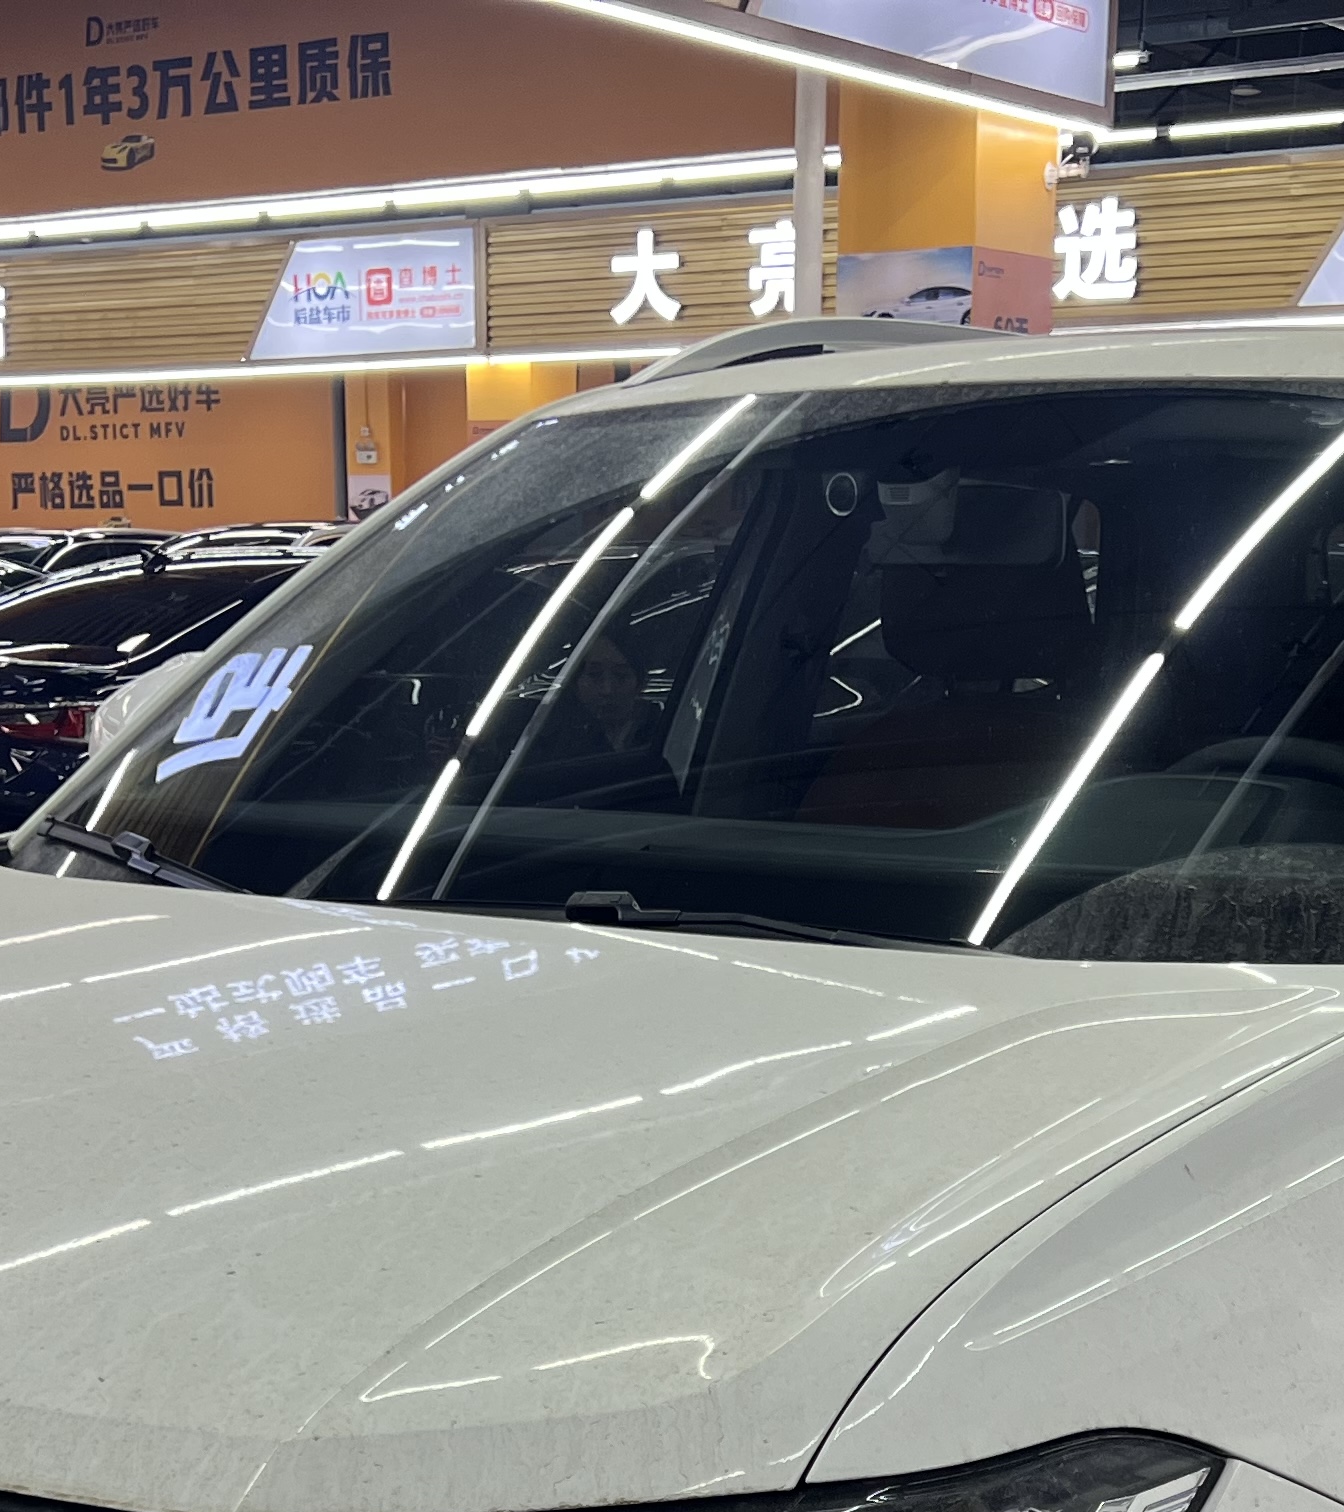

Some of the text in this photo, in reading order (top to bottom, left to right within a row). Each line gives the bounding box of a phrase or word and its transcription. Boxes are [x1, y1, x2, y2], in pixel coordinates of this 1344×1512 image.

[293, 304, 351, 325] 后盐车市
[60, 421, 186, 442] DL.STICT MFV
[12, 467, 215, 510] 严格选品一口价
